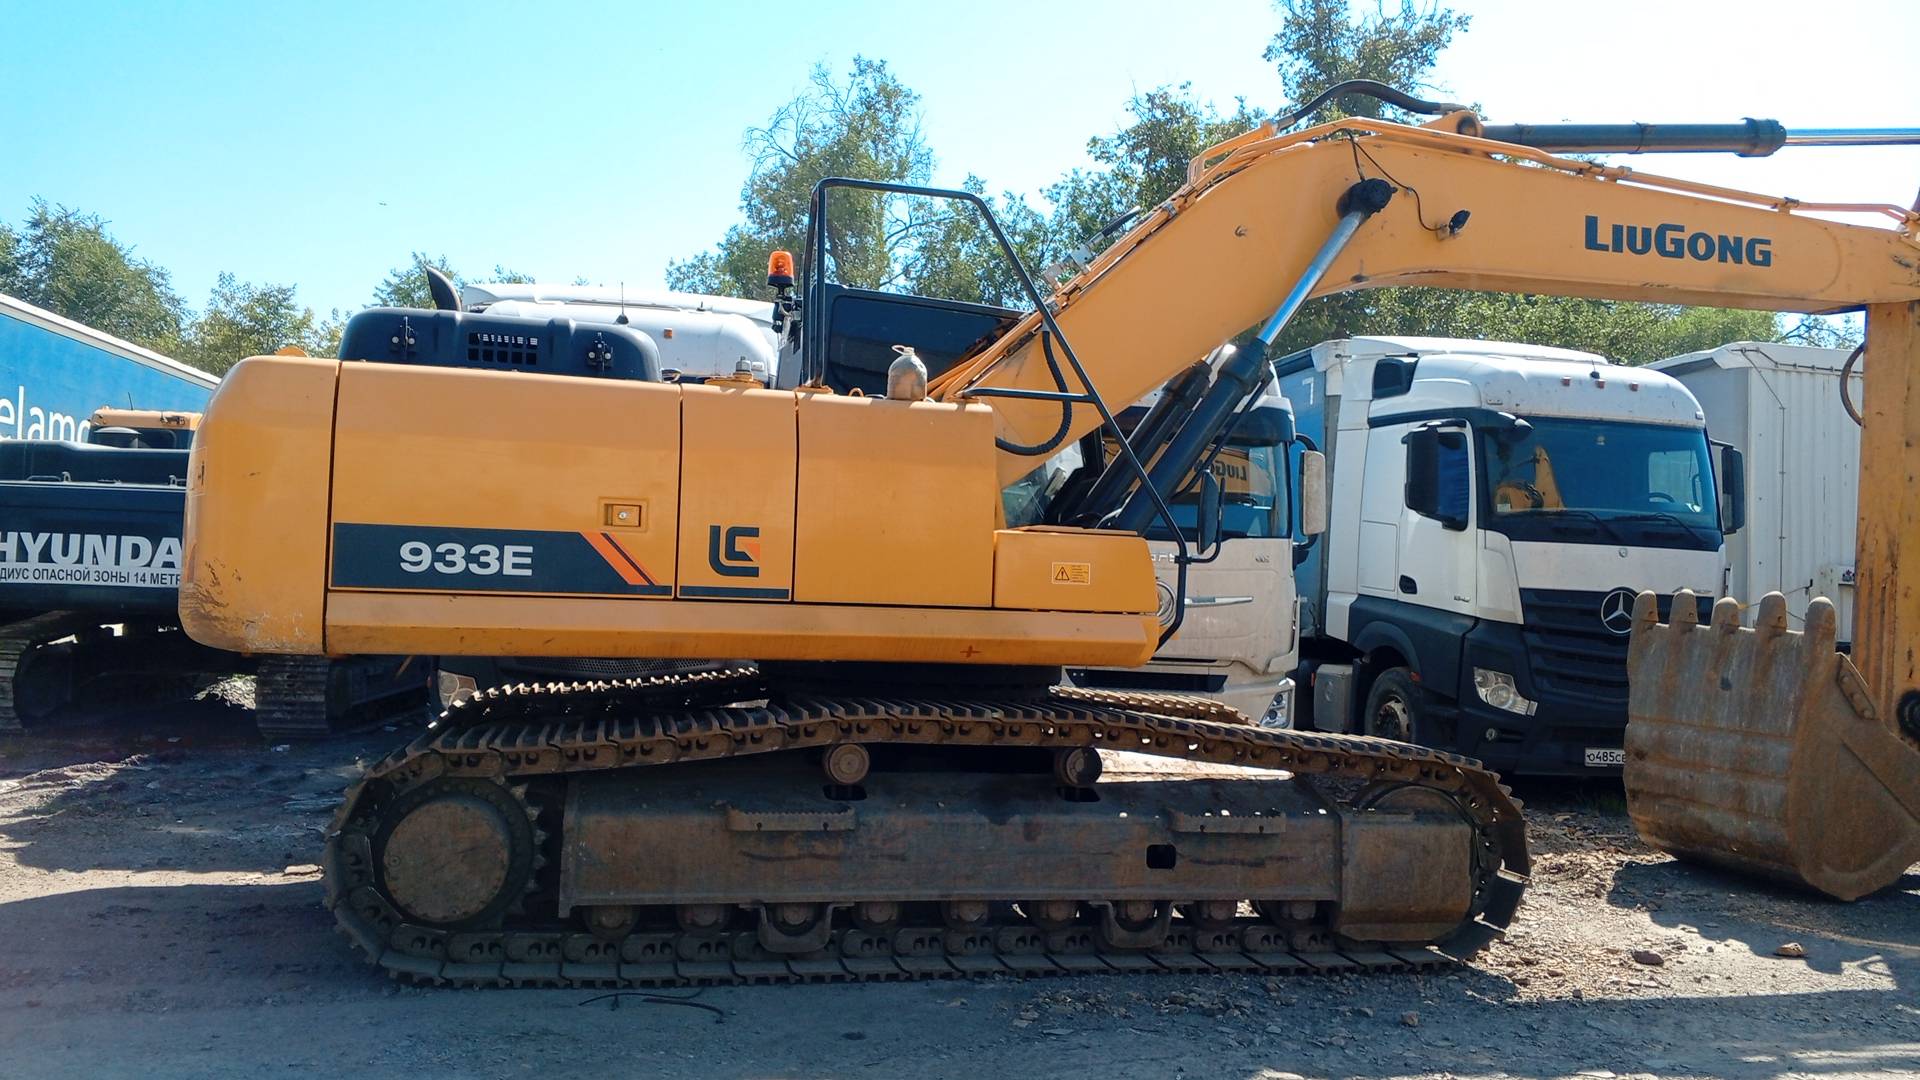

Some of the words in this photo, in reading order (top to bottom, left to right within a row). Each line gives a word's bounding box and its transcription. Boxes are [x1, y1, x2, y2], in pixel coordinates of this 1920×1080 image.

[0, 531, 184, 569] HYUNDA
[399, 541, 534, 577] 933E
[0, 567, 30, 581] ДИУС
[32, 567, 91, 582] ОПАСНОЙ
[93, 571, 130, 583] ЗОНЫ
[133, 571, 147, 585] 14
[149, 573, 181, 586] МЕТР
